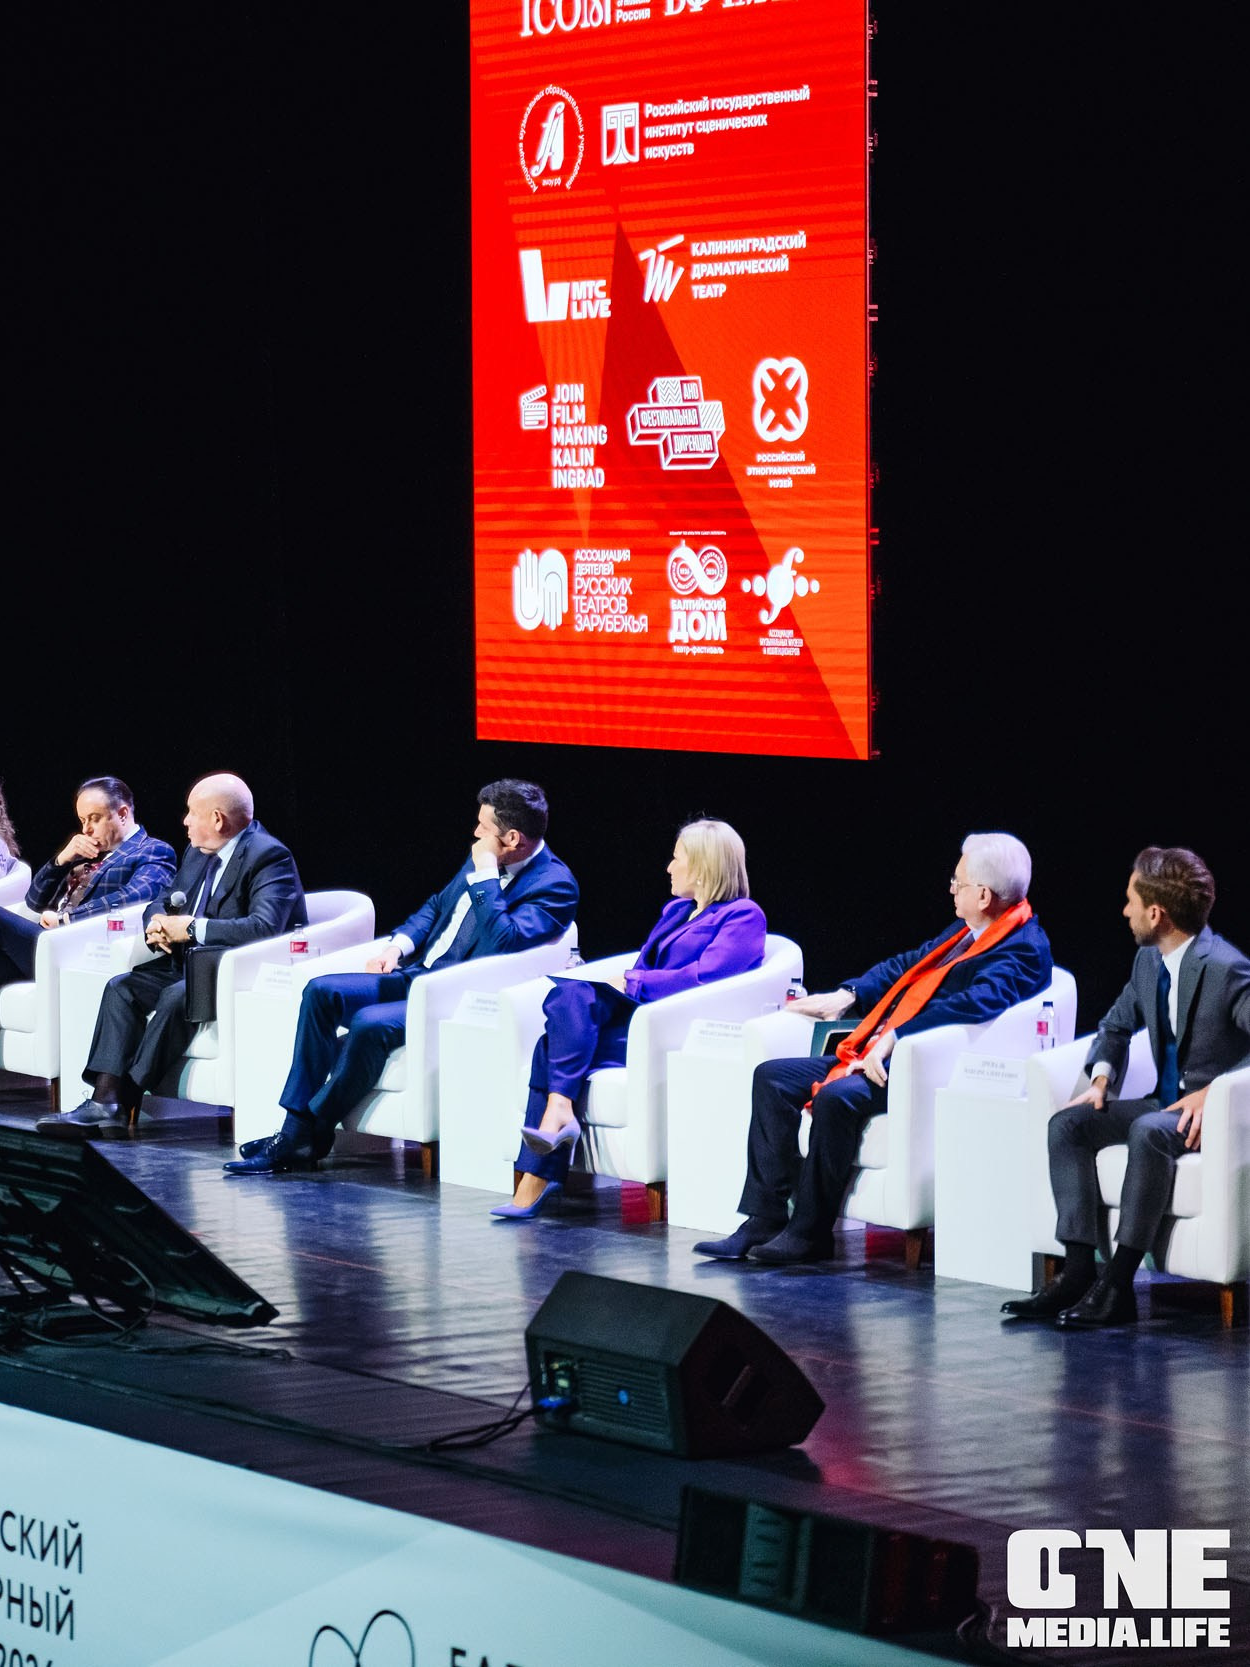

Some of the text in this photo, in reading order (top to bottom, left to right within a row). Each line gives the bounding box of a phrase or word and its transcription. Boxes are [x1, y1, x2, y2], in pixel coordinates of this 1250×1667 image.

[616, 8, 650, 23] Россия
[644, 84, 811, 118] Российский государственный
[644, 114, 768, 138] институт сценических
[644, 142, 695, 160] искусств
[691, 231, 807, 256] КАЛИНИНГРАДСКИЙ
[691, 254, 789, 280] ДРАМАТИЧЕСКИЙ
[692, 284, 727, 299] ТЕАТР
[571, 299, 611, 320] LIVE
[552, 384, 584, 403] JOIN
[683, 382, 699, 400] АНО
[552, 404, 586, 425] FILM
[640, 408, 699, 427] ФЕСТИВАЛЬНАЯ
[552, 425, 608, 446] MAKING
[673, 434, 713, 454] ДИРЕКЦИЯ
[552, 447, 595, 467] KALIN
[756, 450, 806, 463] РОССИЙСКИЙ
[552, 467, 605, 489] INGRAD
[746, 463, 816, 476] ЭТНОГРАФИЧЕСКИЙ
[768, 477, 793, 488] МУЗЕЙ
[575, 549, 631, 563] АССОЦИАЦИЯ
[575, 562, 614, 576] ДЕЯТЕЛЕЙ
[575, 577, 633, 595] РУССКИХ
[573, 596, 628, 614] ТЕАТРОВ
[670, 597, 726, 611] БАЛТИЙСКИЙ
[575, 614, 648, 633] ЗАРУБЕЖЬЯ
[668, 611, 727, 643] ДОМ
